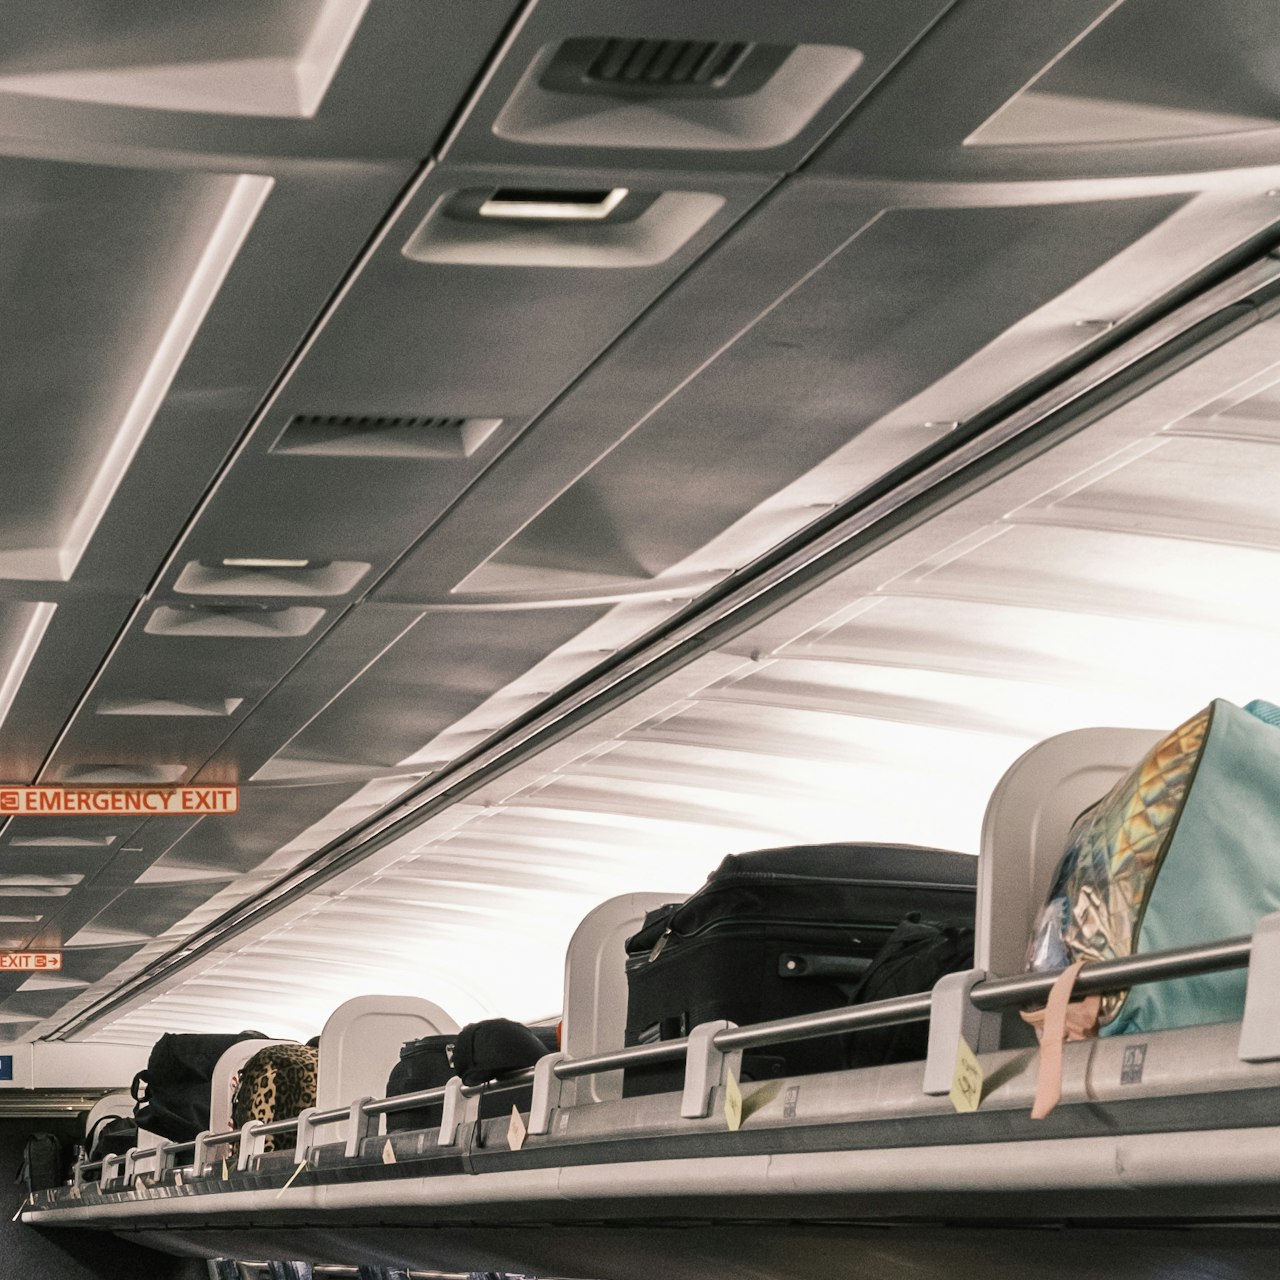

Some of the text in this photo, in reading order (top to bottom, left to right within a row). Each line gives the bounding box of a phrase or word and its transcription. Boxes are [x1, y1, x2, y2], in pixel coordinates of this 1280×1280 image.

[26, 790, 232, 811] EMERGENCY EXIT
[0, 955, 31, 968] EXIT
